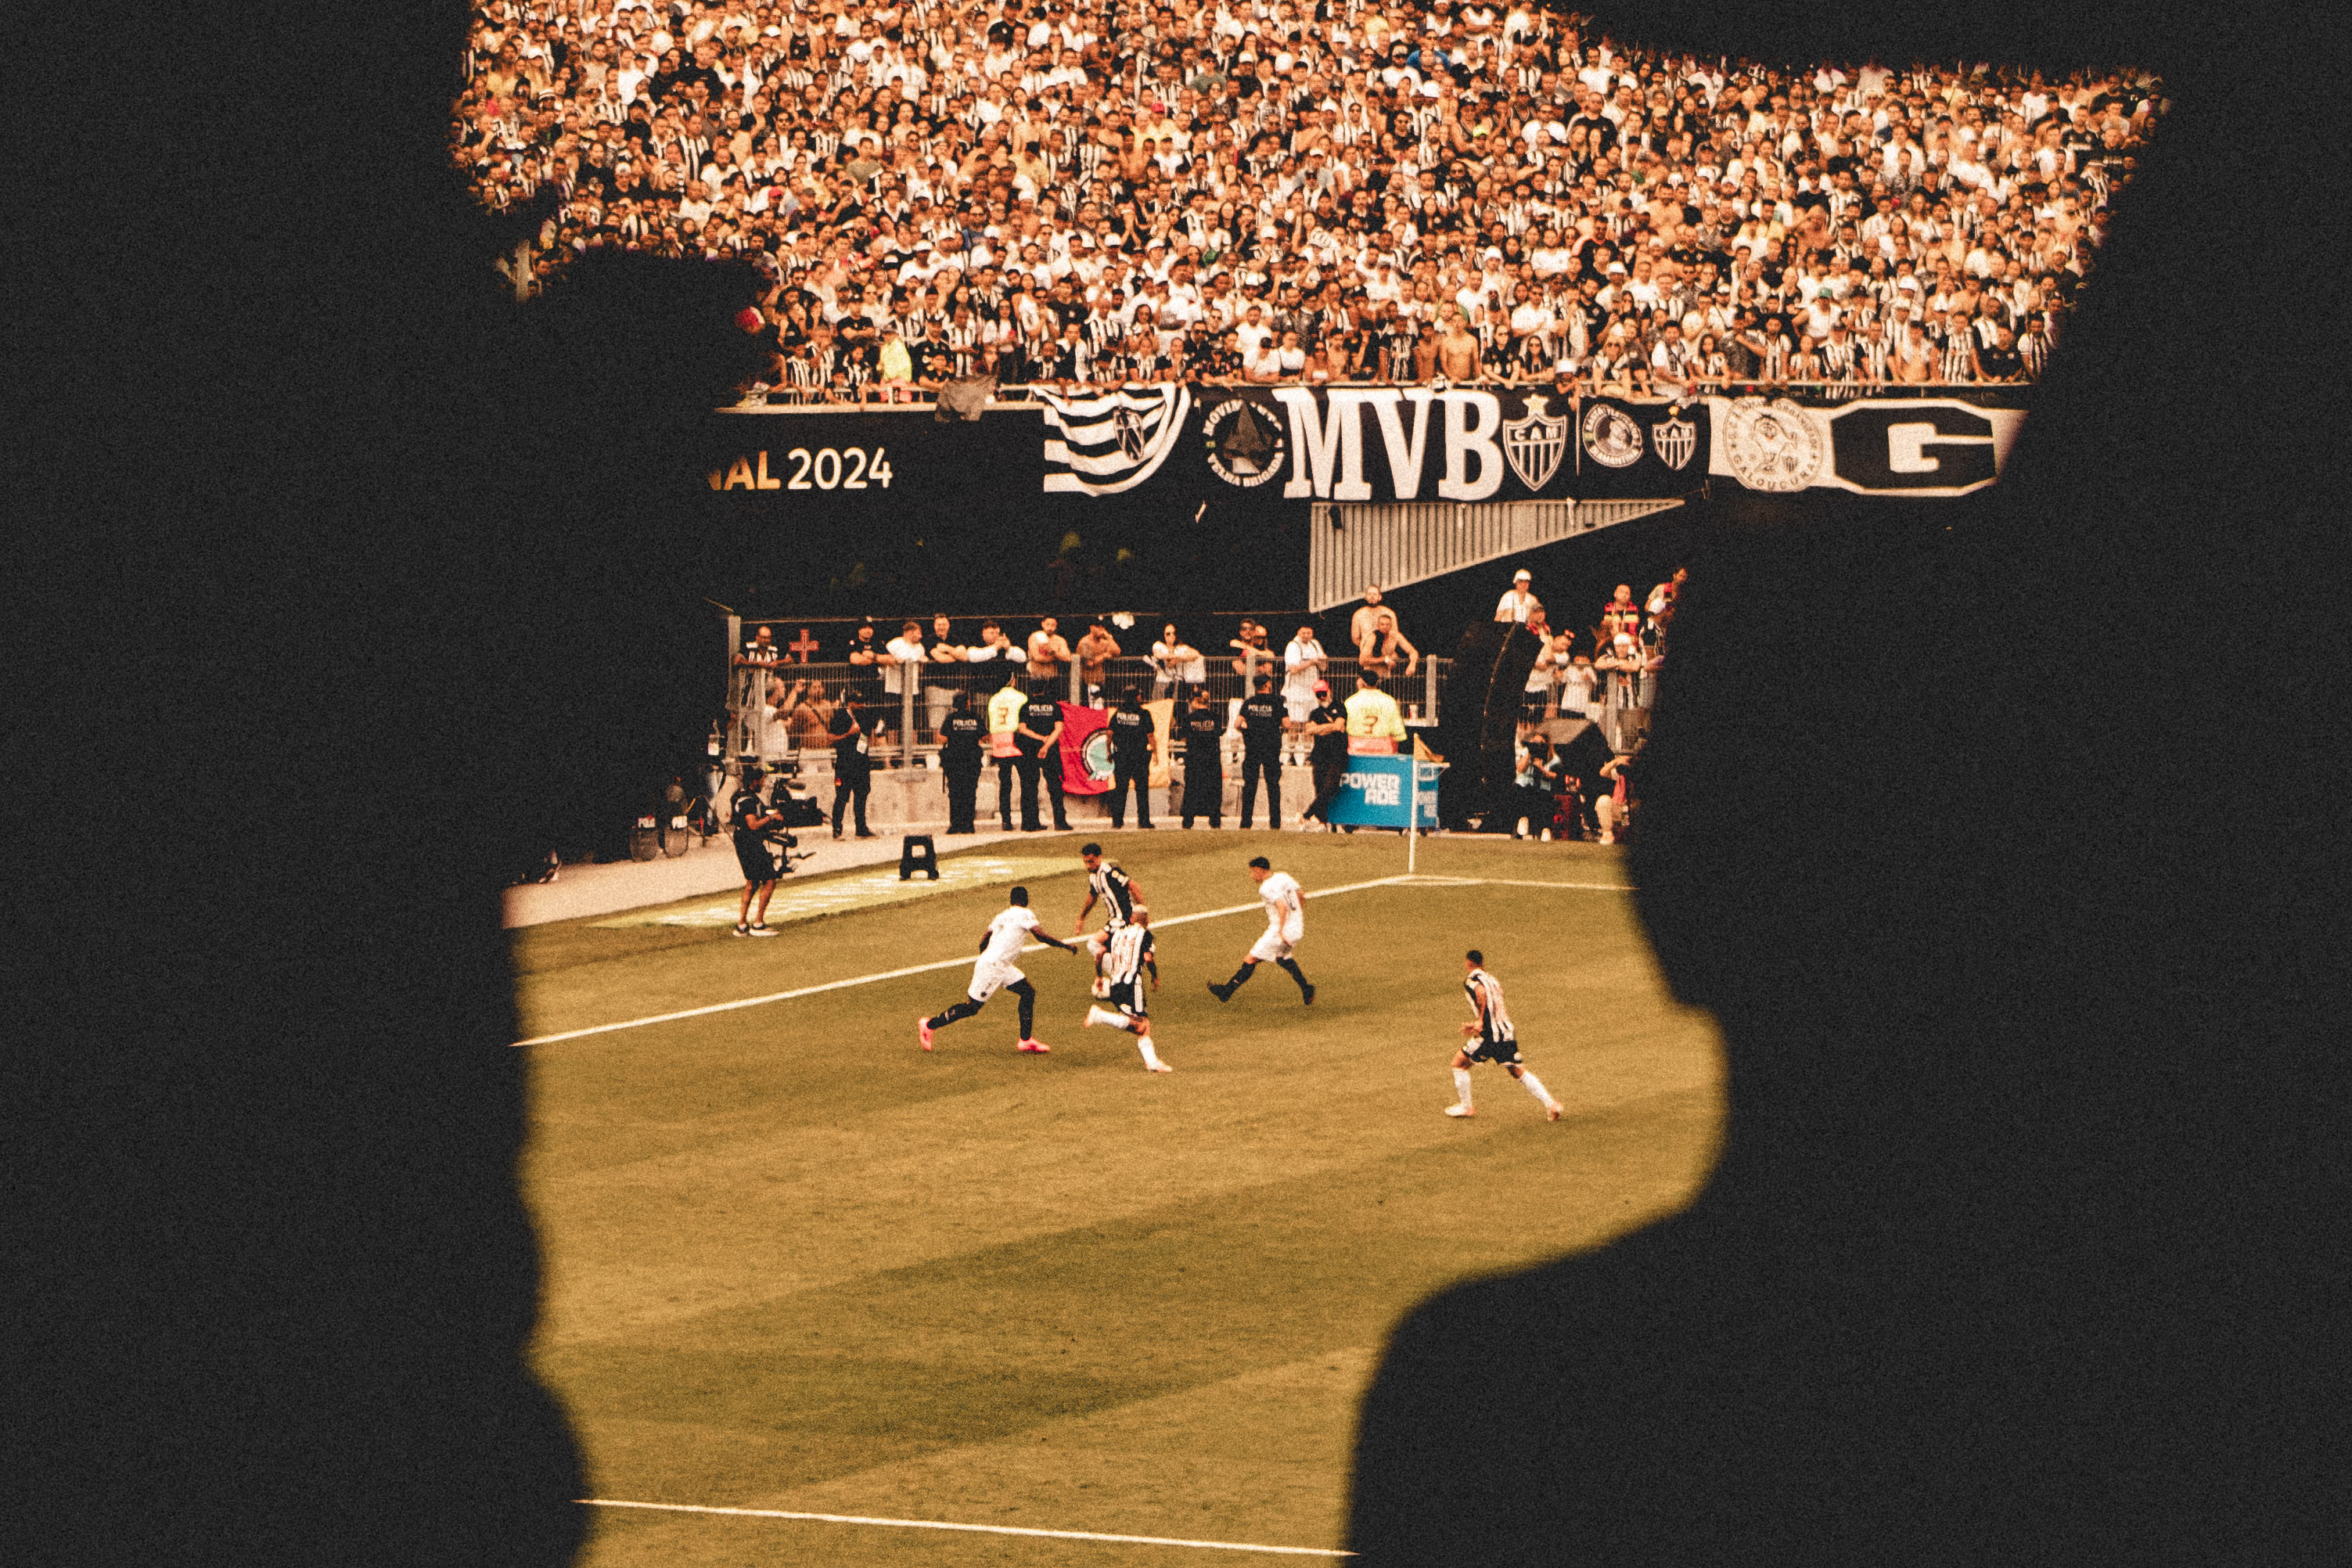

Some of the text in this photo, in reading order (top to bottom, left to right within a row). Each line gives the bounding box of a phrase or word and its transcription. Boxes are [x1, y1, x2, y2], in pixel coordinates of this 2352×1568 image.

[1514, 425, 1559, 441] CAM
[1271, 388, 1504, 501] MVB
[787, 447, 893, 491] 2024
[1339, 772, 1401, 789] POWER
[1363, 789, 1402, 806] ADE
